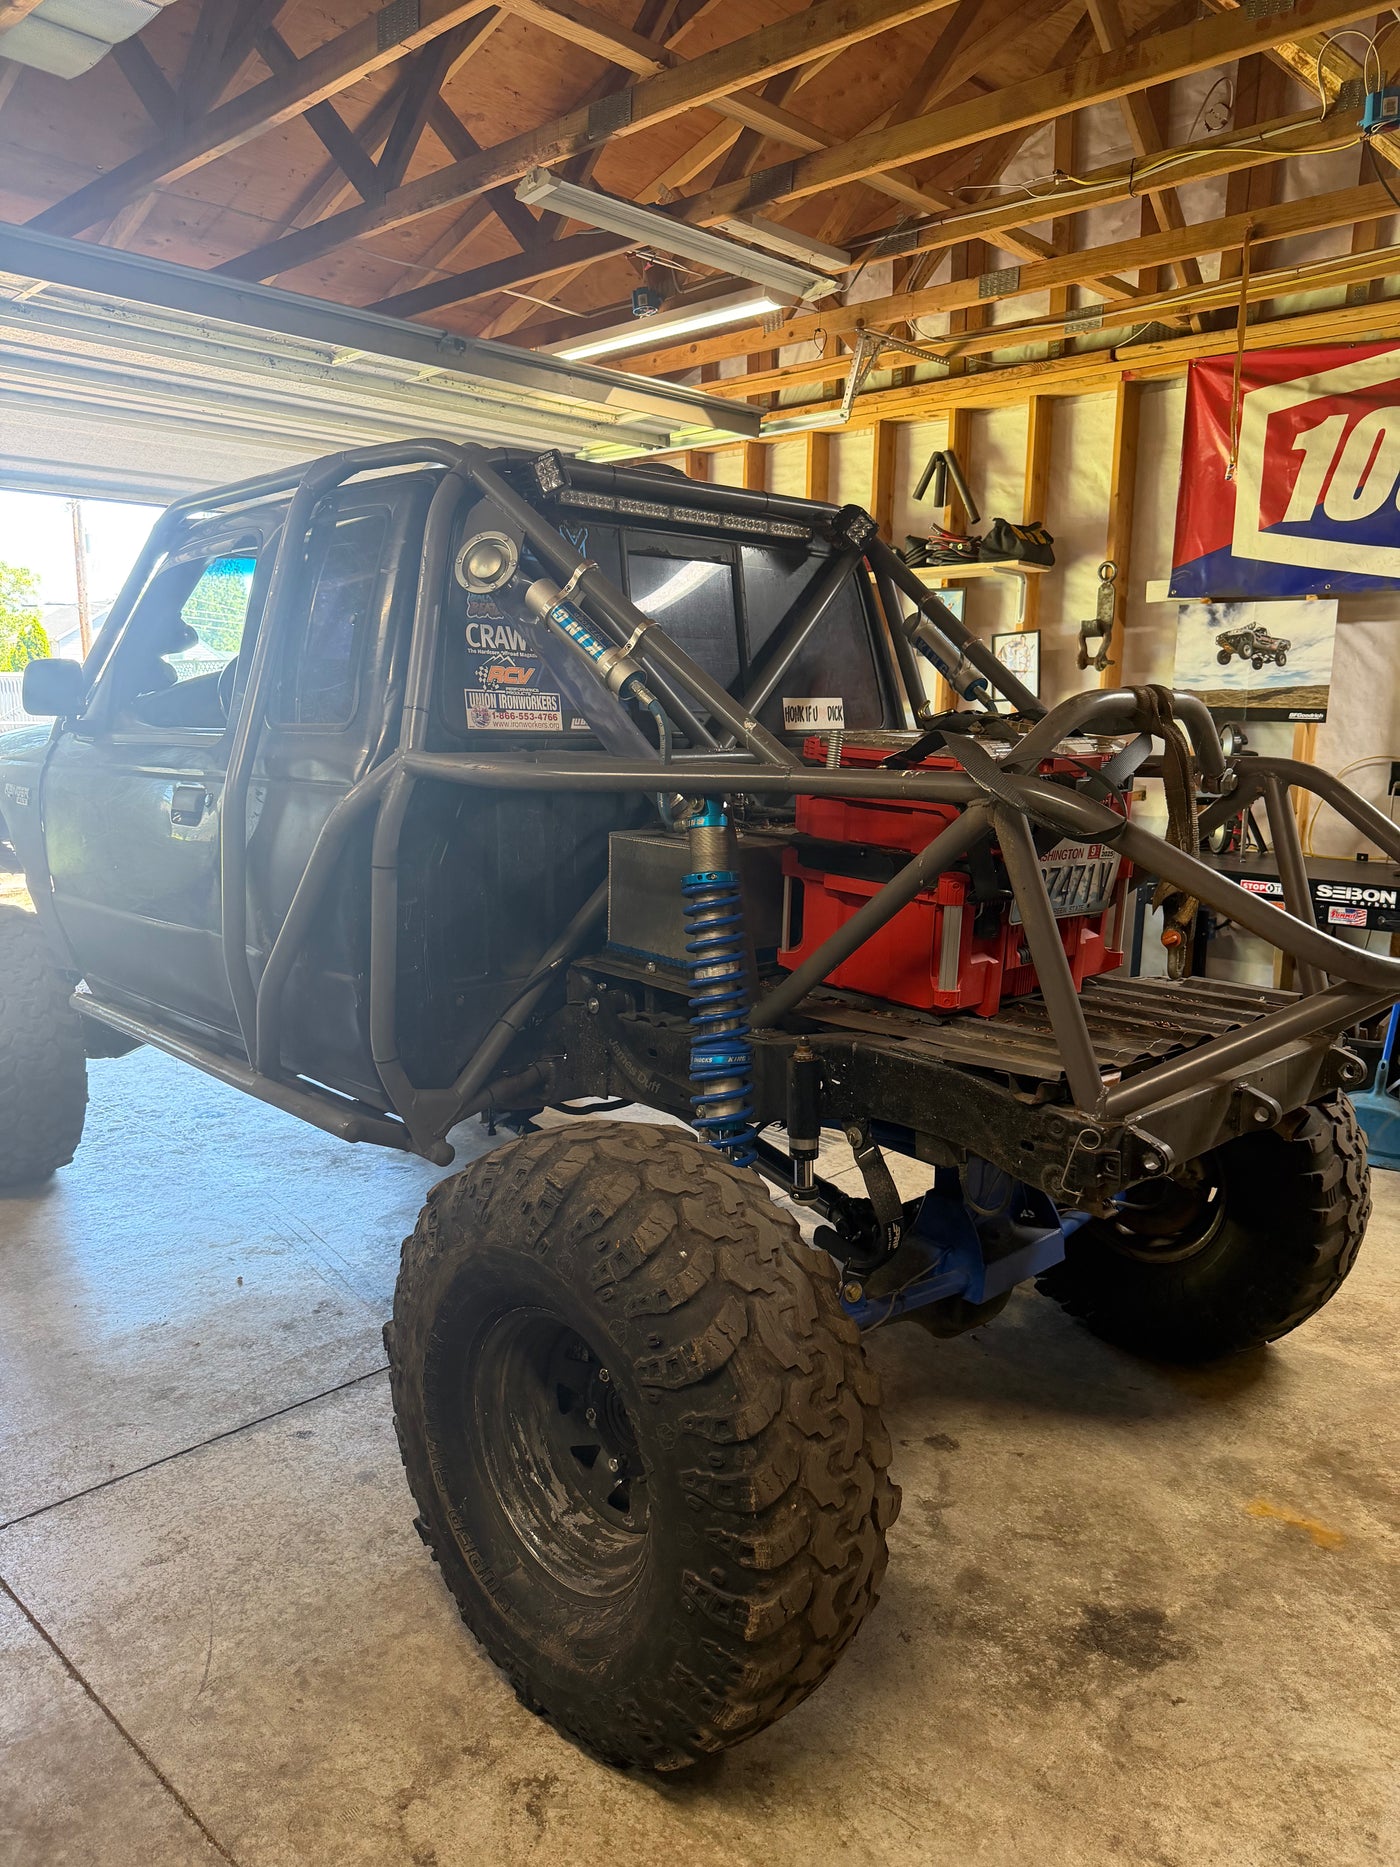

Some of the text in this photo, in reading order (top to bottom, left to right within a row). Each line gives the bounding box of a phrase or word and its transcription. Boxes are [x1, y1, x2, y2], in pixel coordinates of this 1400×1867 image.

[1282, 406, 1400, 523] 10
[465, 622, 527, 651] CRAW
[552, 608, 604, 656] KING
[487, 665, 536, 685] RCV
[469, 692, 557, 711] UNION IRONWORKERS
[492, 712, 558, 721] 1-866-553-4766
[493, 721, 560, 730] www.ironworkers.org
[1041, 848, 1084, 862] SHINGTON
[1316, 884, 1397, 904] SEBON
[1352, 900, 1396, 909] carbon
